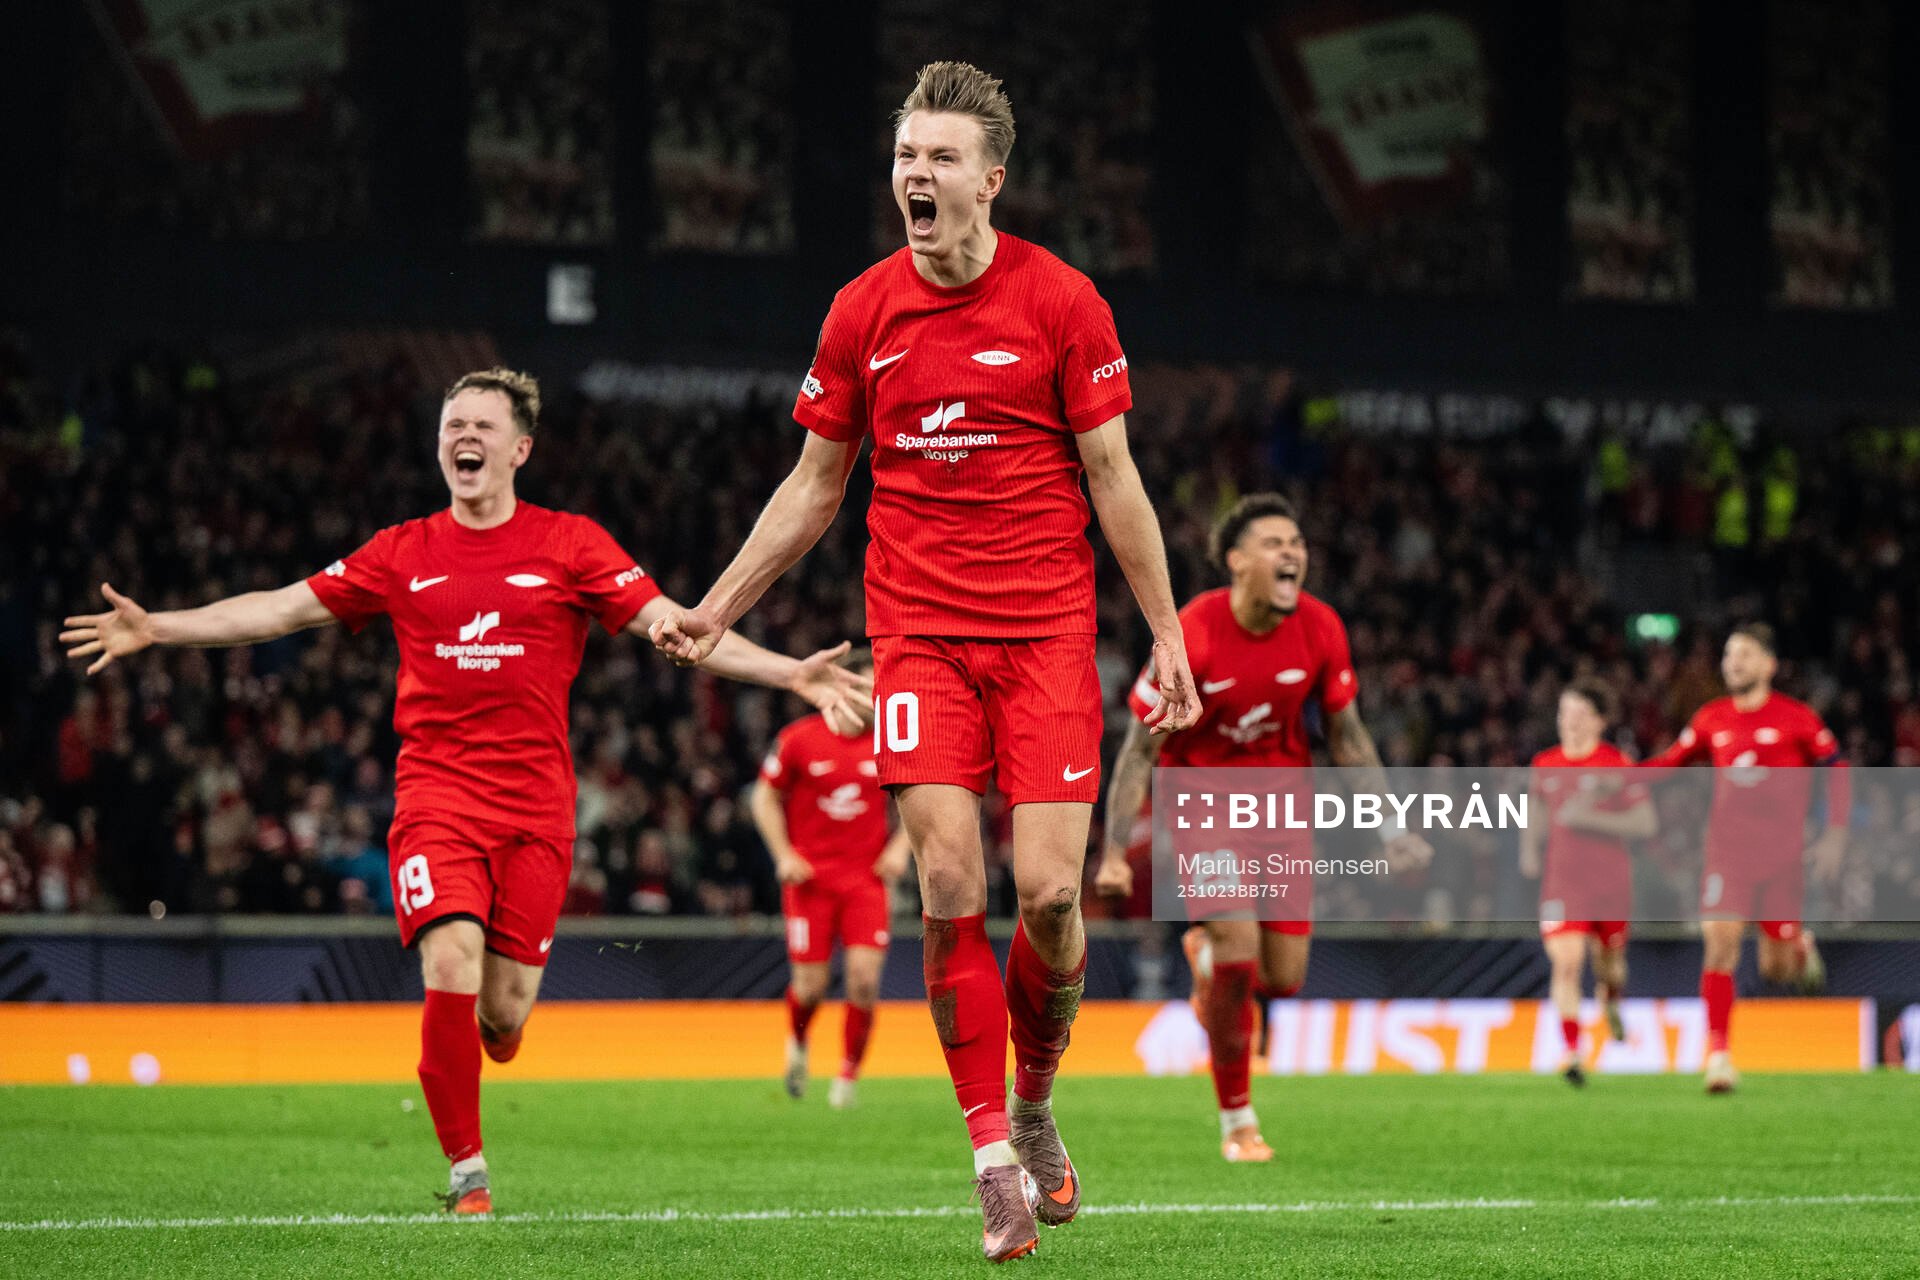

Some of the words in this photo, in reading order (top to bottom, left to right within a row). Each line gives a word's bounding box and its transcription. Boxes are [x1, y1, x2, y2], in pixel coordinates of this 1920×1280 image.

[895, 433, 998, 450] Sparebanken
[921, 448, 969, 463] Norge
[435, 643, 525, 660] Sparebanken
[457, 656, 501, 672] Norge
[874, 692, 920, 755] 10
[398, 854, 435, 916] 19
